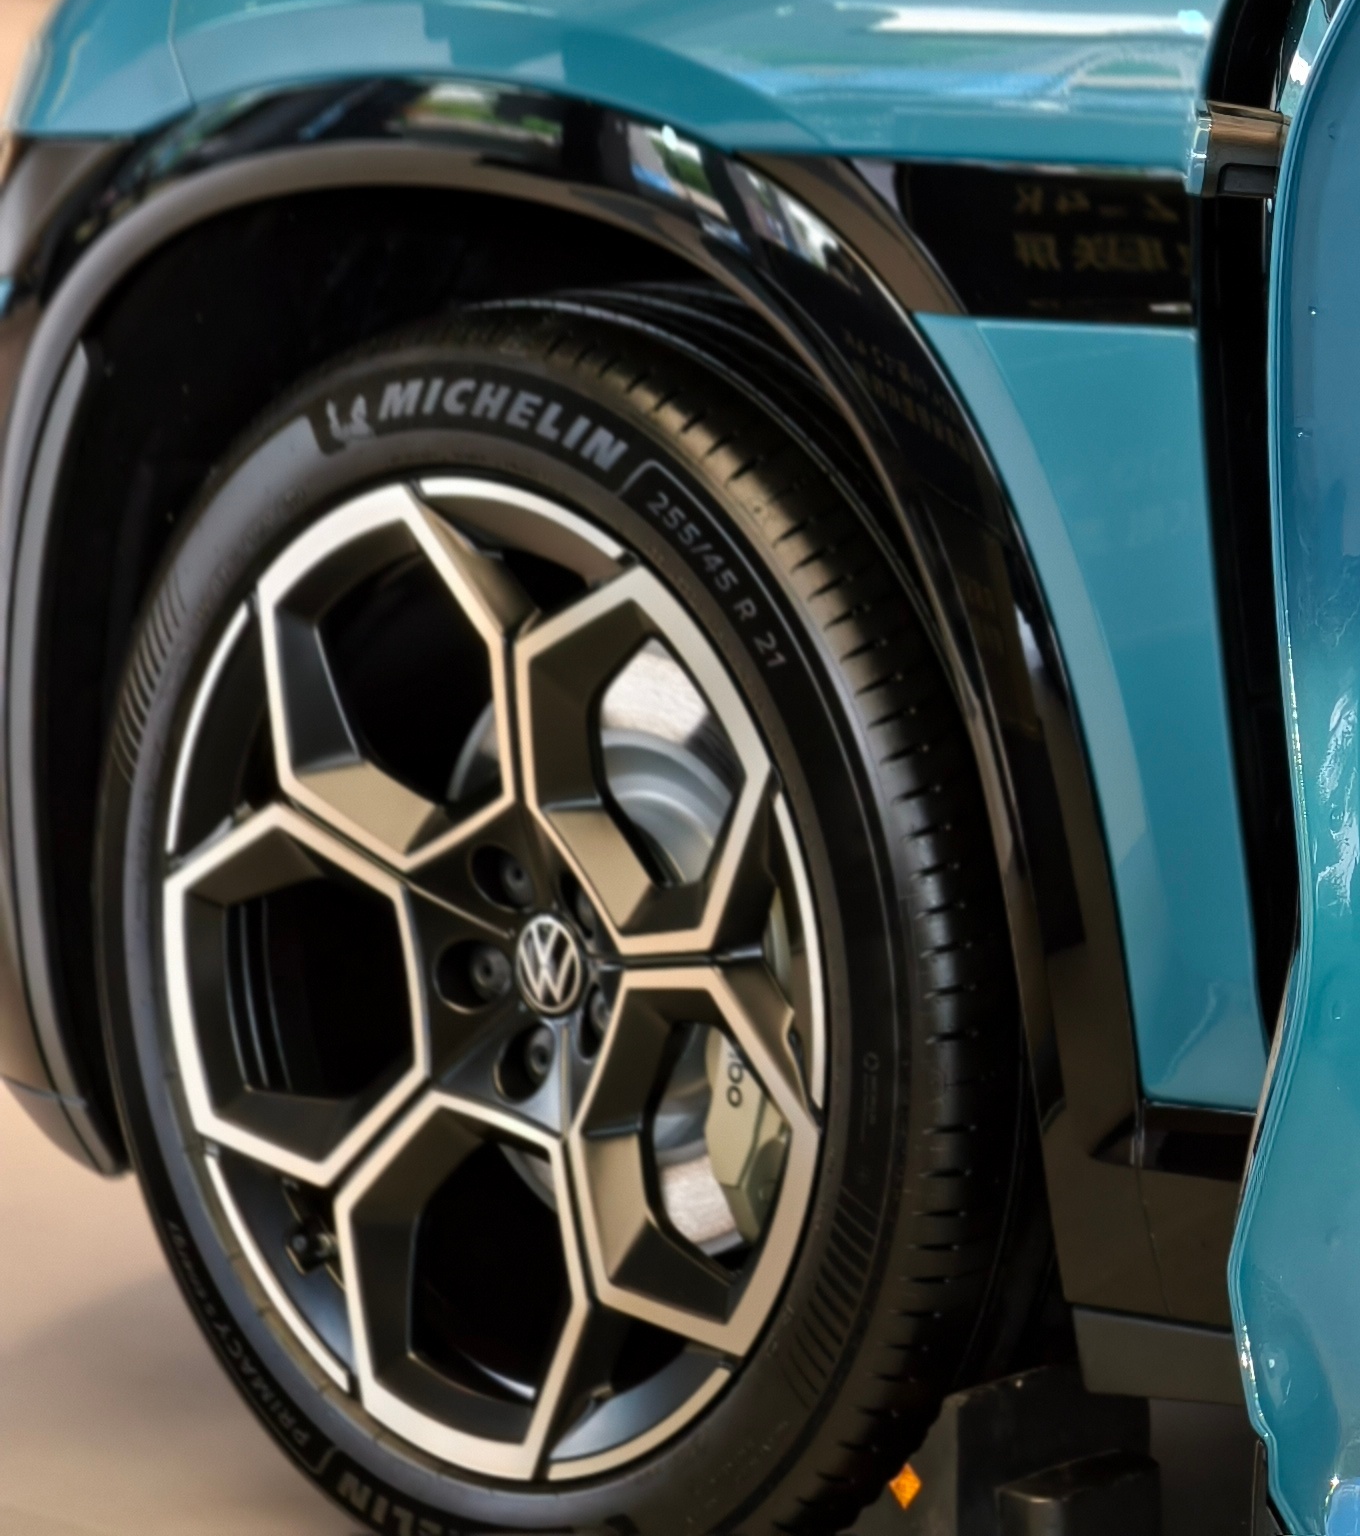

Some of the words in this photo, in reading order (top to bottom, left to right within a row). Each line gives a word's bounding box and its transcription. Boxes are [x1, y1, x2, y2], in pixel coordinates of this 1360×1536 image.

[378, 378, 629, 471] MICHELIN
[645, 491, 738, 592] 255/45
[733, 594, 760, 622] R
[752, 630, 787, 668] 21
